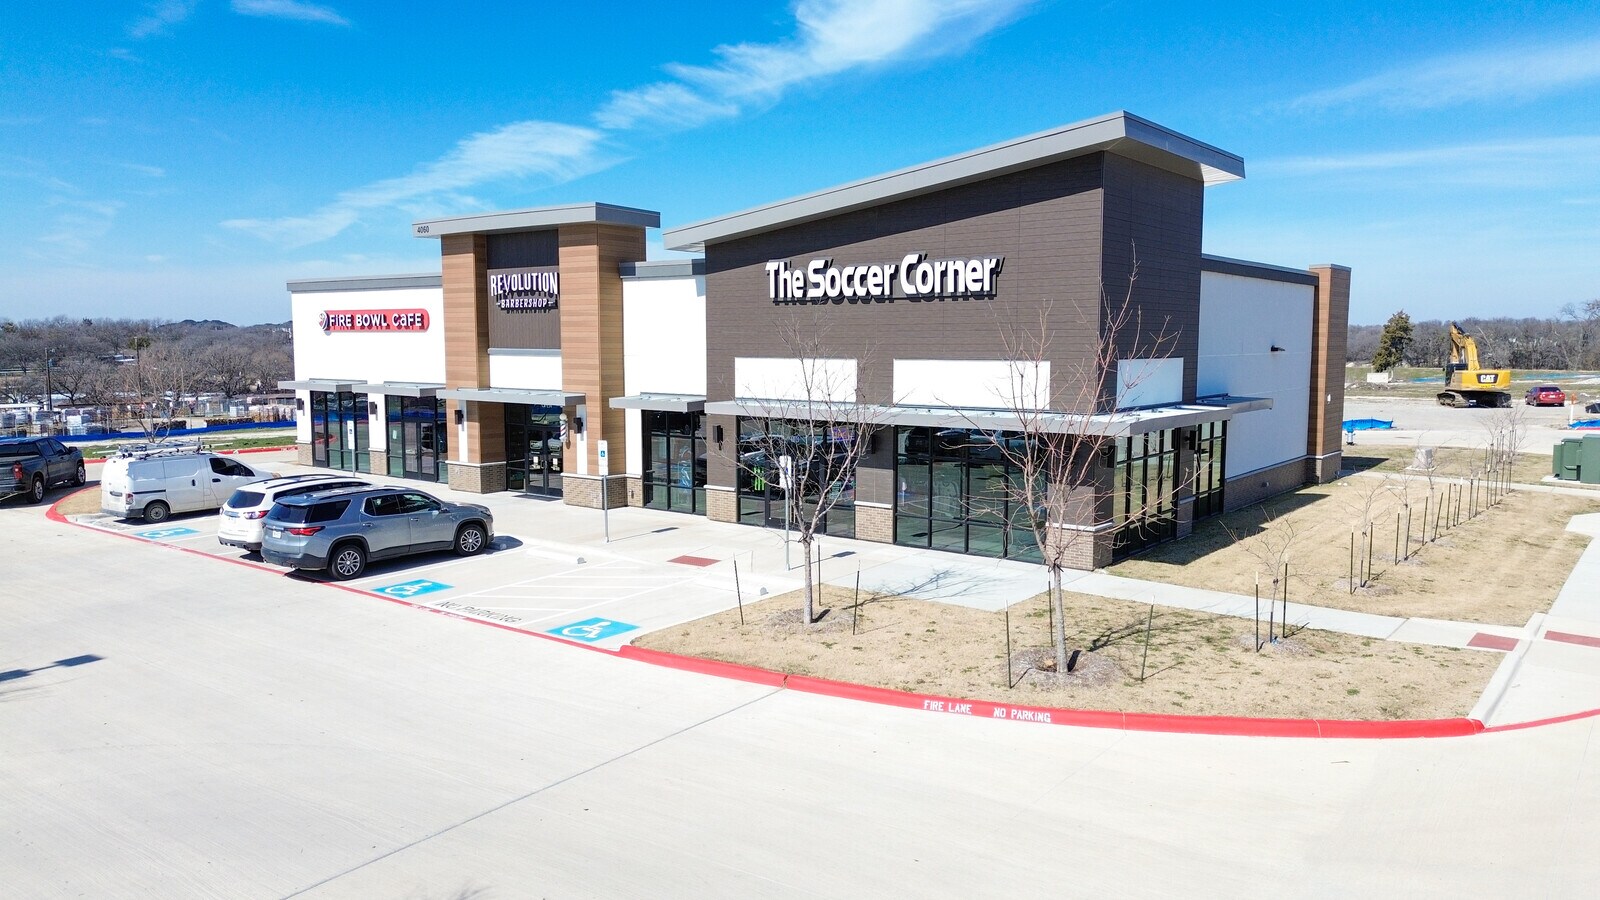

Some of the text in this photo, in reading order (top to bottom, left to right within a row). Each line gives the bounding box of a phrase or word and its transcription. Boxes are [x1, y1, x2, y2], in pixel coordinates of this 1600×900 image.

[490, 272, 558, 297] REVOLUTION
[765, 254, 997, 299] The Soccer Corner
[501, 298, 548, 309] BARBERSHOP
[356, 314, 388, 327] BOWL
[1480, 374, 1496, 383] CAT
[463, 605, 522, 623] PARKING
[923, 700, 1051, 723] FIRE LANE NO PARKING
